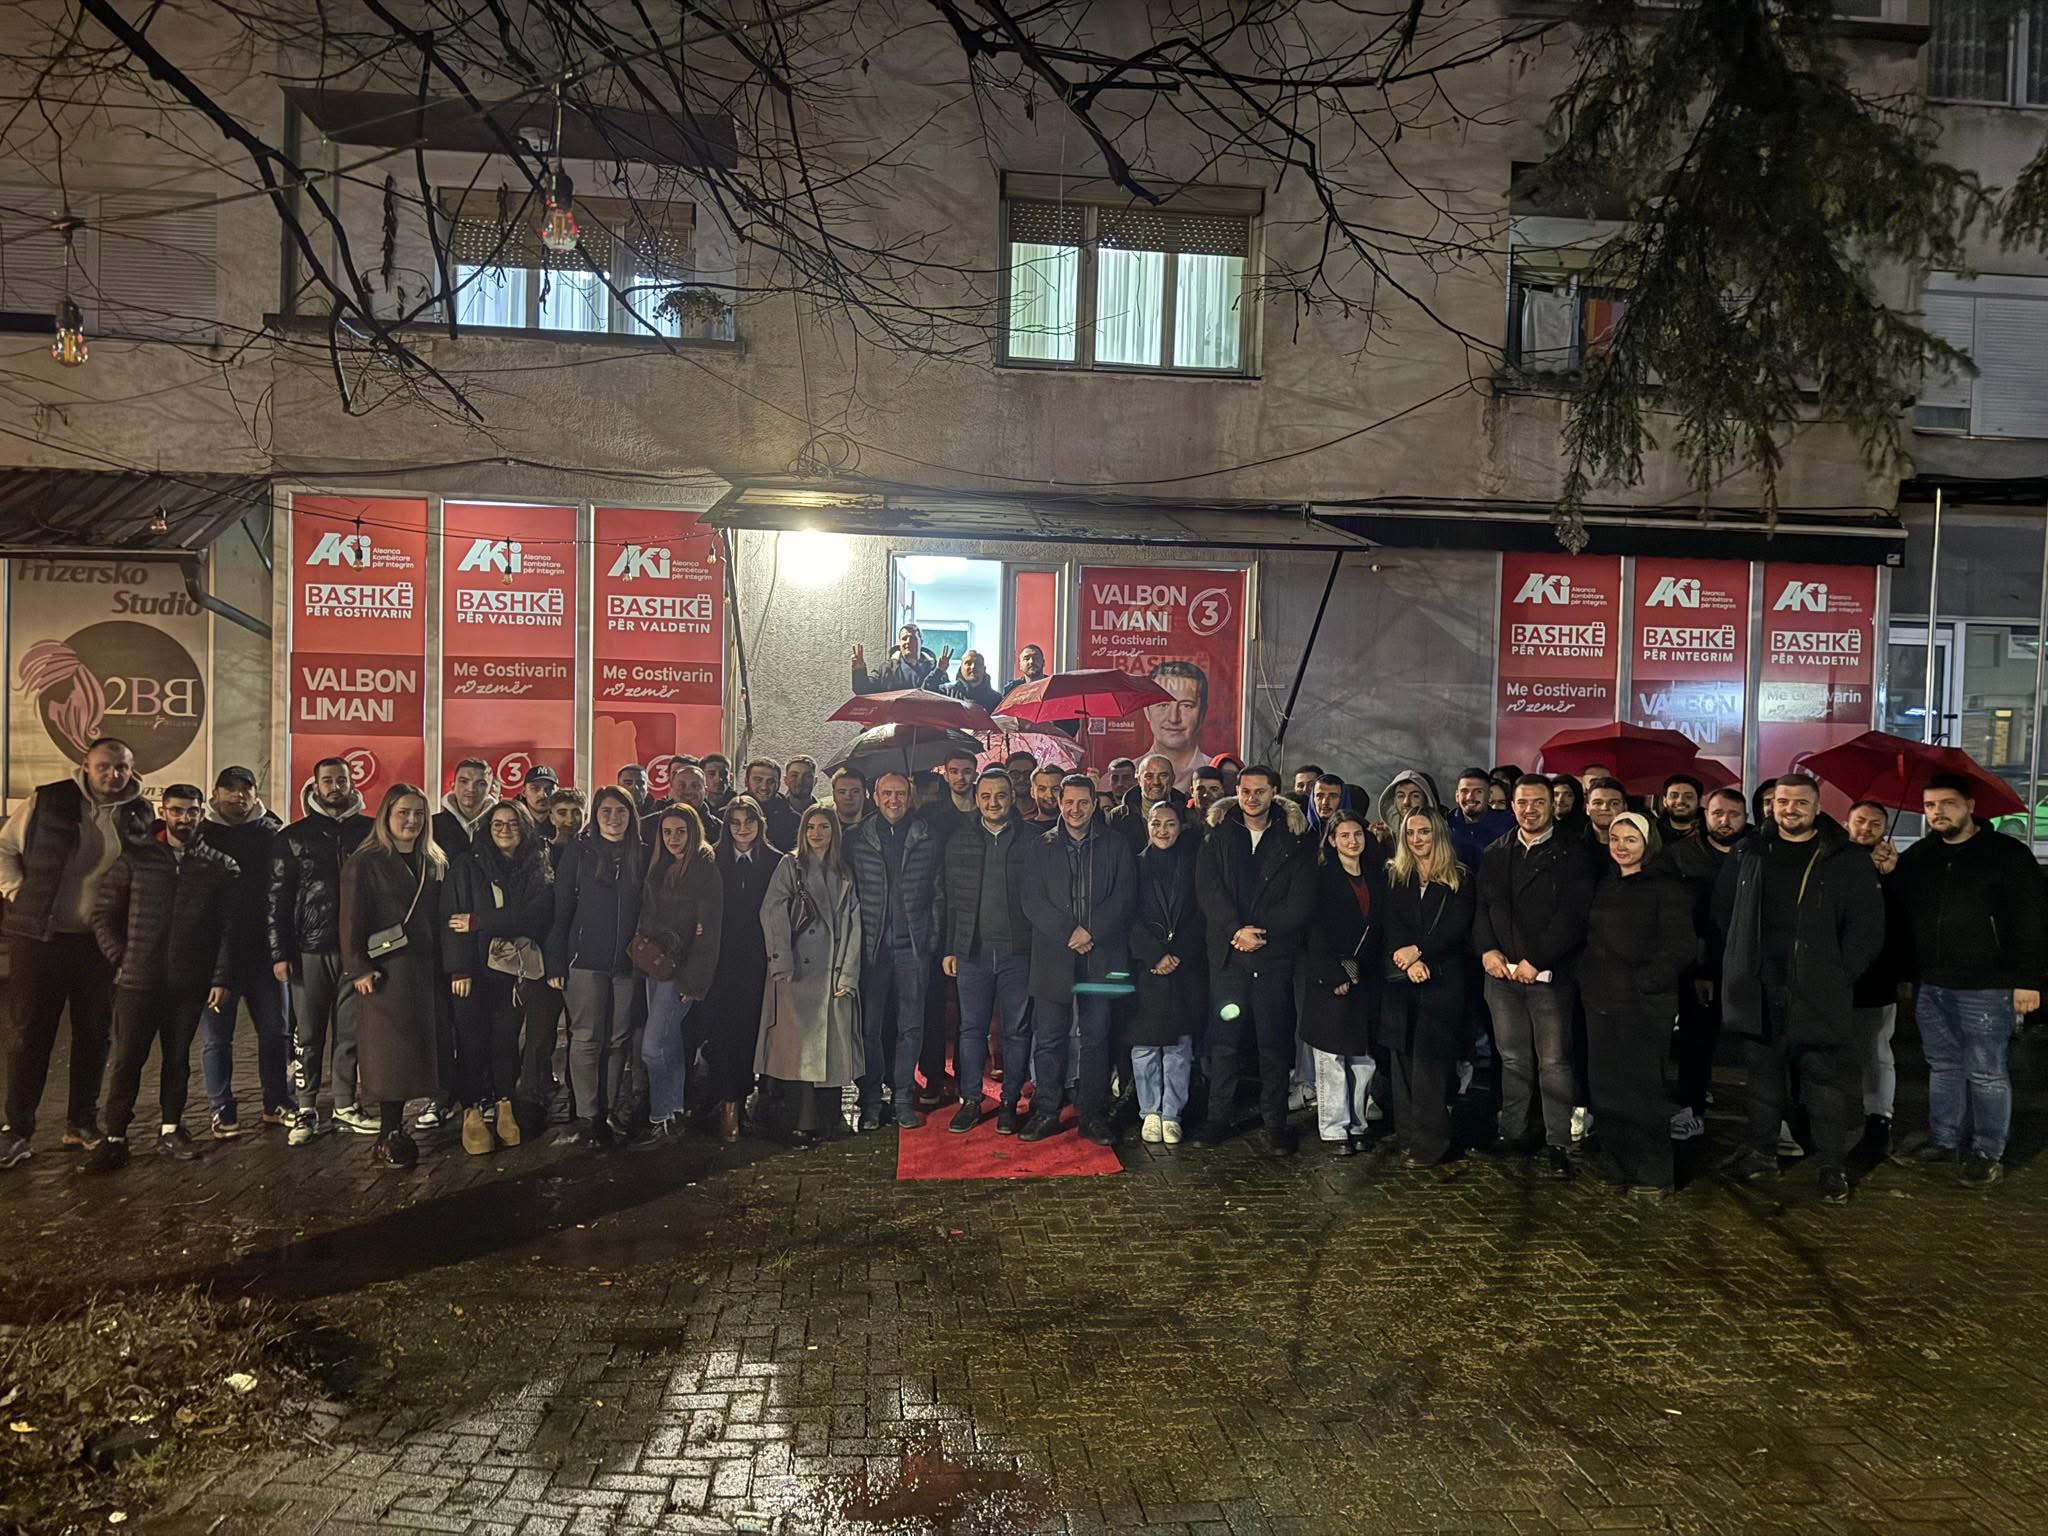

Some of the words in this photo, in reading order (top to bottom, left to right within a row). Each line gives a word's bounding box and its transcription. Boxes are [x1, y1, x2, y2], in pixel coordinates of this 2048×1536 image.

[112, 590, 203, 616] Studio
[308, 583, 411, 606] BASHKË
[459, 590, 561, 613] BASHKË
[1092, 584, 1186, 606] VALBON
[306, 606, 330, 617] PËR
[334, 608, 412, 619] GOSTIVARIN
[610, 594, 710, 618] BASHKË
[1201, 601, 1218, 626] 3
[457, 612, 483, 623] PËR
[489, 614, 562, 626] VALBONIN
[608, 619, 634, 630] PËR
[641, 621, 711, 633] VALDETIN
[1091, 610, 1168, 631] LIMANI
[1091, 635, 1108, 645] Me
[1111, 635, 1168, 646] Gostivarin
[1514, 622, 1604, 645] BASHKË
[1646, 626, 1733, 648] BASHKË
[1773, 630, 1859, 651] BASHKË
[1512, 645, 1534, 655] PËR
[1539, 646, 1603, 657] VALBONIN
[1644, 649, 1667, 660] PËR
[1671, 651, 1733, 662] INTEGRIM
[1771, 653, 1794, 664] PËR
[1799, 655, 1859, 666] VALDETIN
[303, 667, 416, 693] VALBON
[454, 663, 478, 676] Me
[483, 663, 567, 677] Gostivarin
[603, 665, 627, 679] Me
[632, 666, 713, 682] Gostivarin
[1507, 683, 1528, 696] Me
[1533, 684, 1606, 698] Gostivarin
[301, 697, 393, 722] LIMANI
[351, 760, 365, 780] 3
[508, 762, 522, 782] 3
[655, 764, 669, 784] 3
